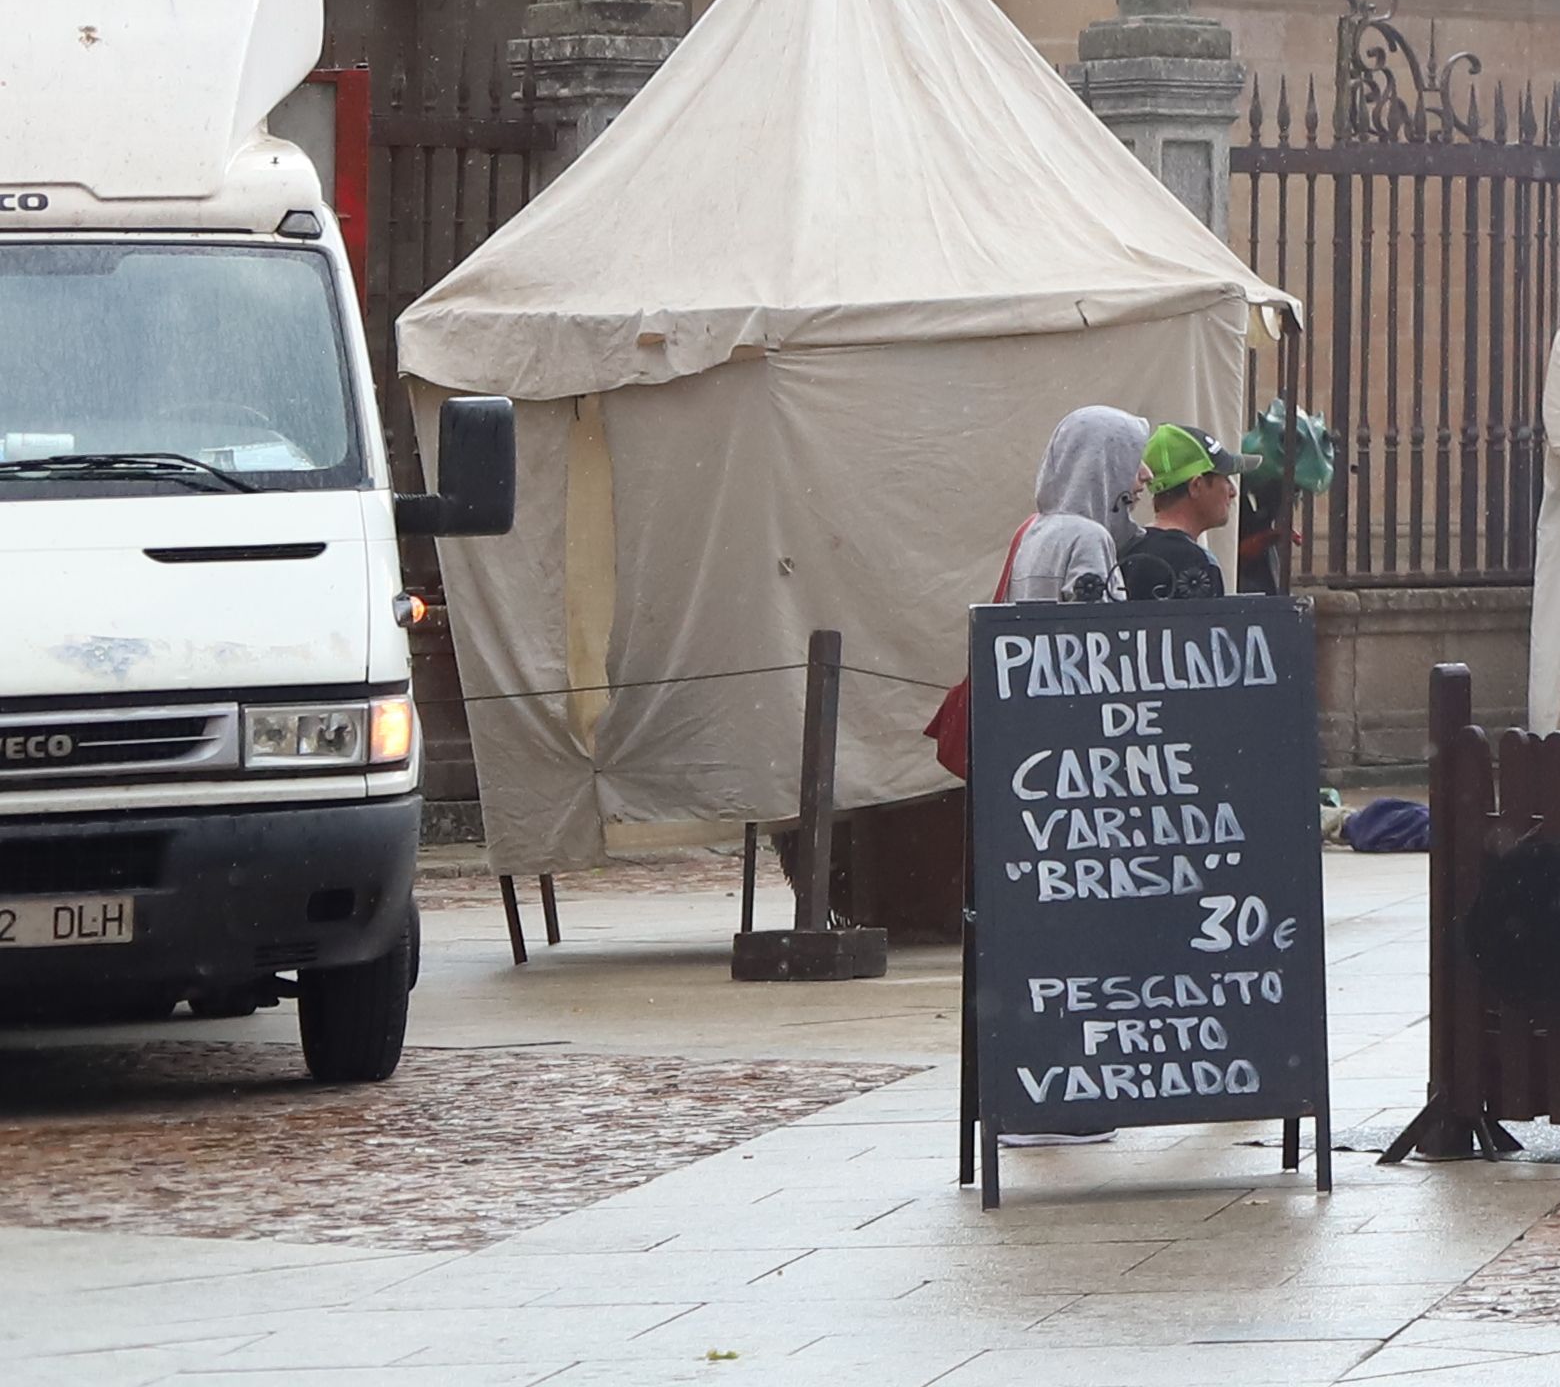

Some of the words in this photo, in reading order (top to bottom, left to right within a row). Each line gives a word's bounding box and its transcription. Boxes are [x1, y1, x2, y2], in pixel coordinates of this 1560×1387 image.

[0, 193, 48, 211] CO
[1101, 701, 1163, 738] DE
[0, 734, 73, 760] ECO
[1011, 742, 1199, 801] CARNE
[54, 903, 123, 939] DLH
